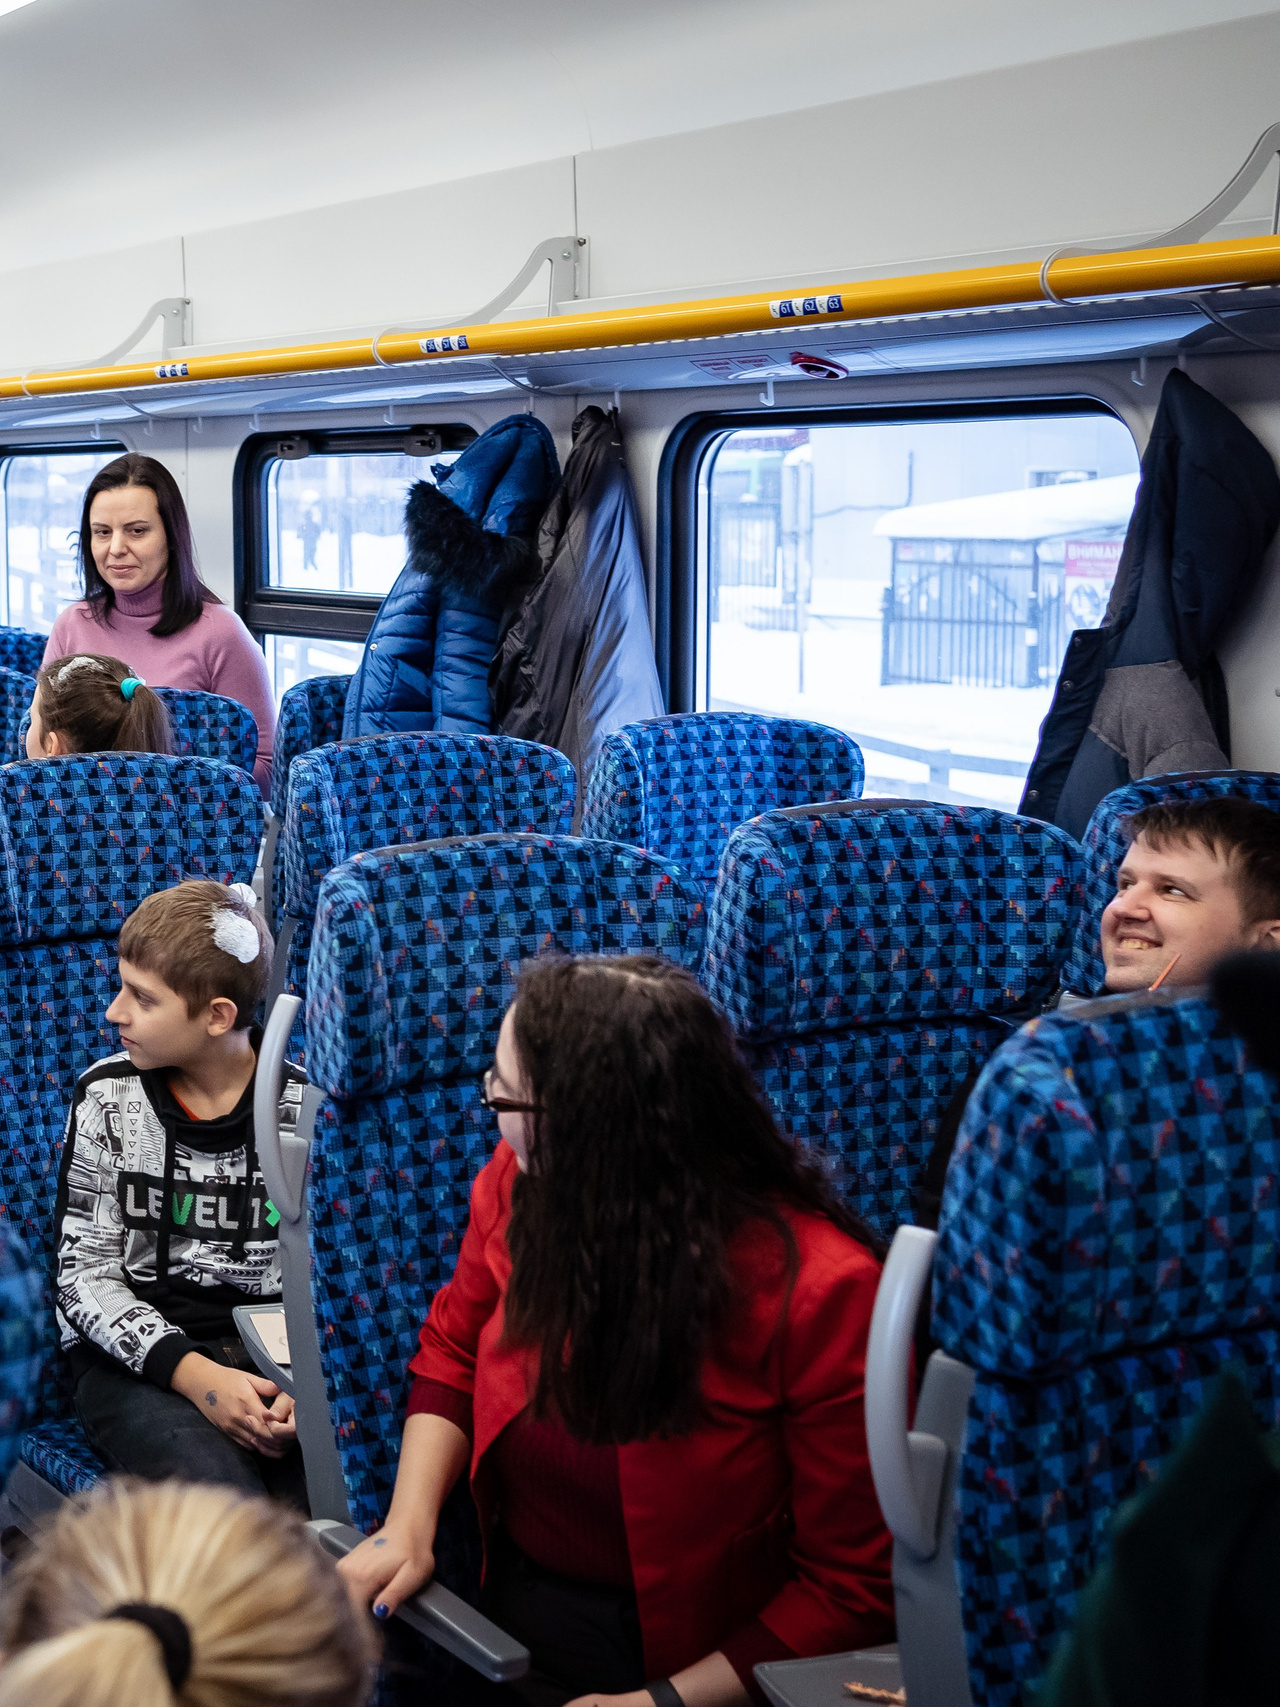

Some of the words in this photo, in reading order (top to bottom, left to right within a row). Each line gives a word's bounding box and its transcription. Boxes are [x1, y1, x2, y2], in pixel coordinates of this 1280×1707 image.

[780, 302, 791, 314] 61
[804, 300, 816, 312] 62
[828, 298, 840, 309] 63
[125, 1184, 239, 1230] LEVEL
